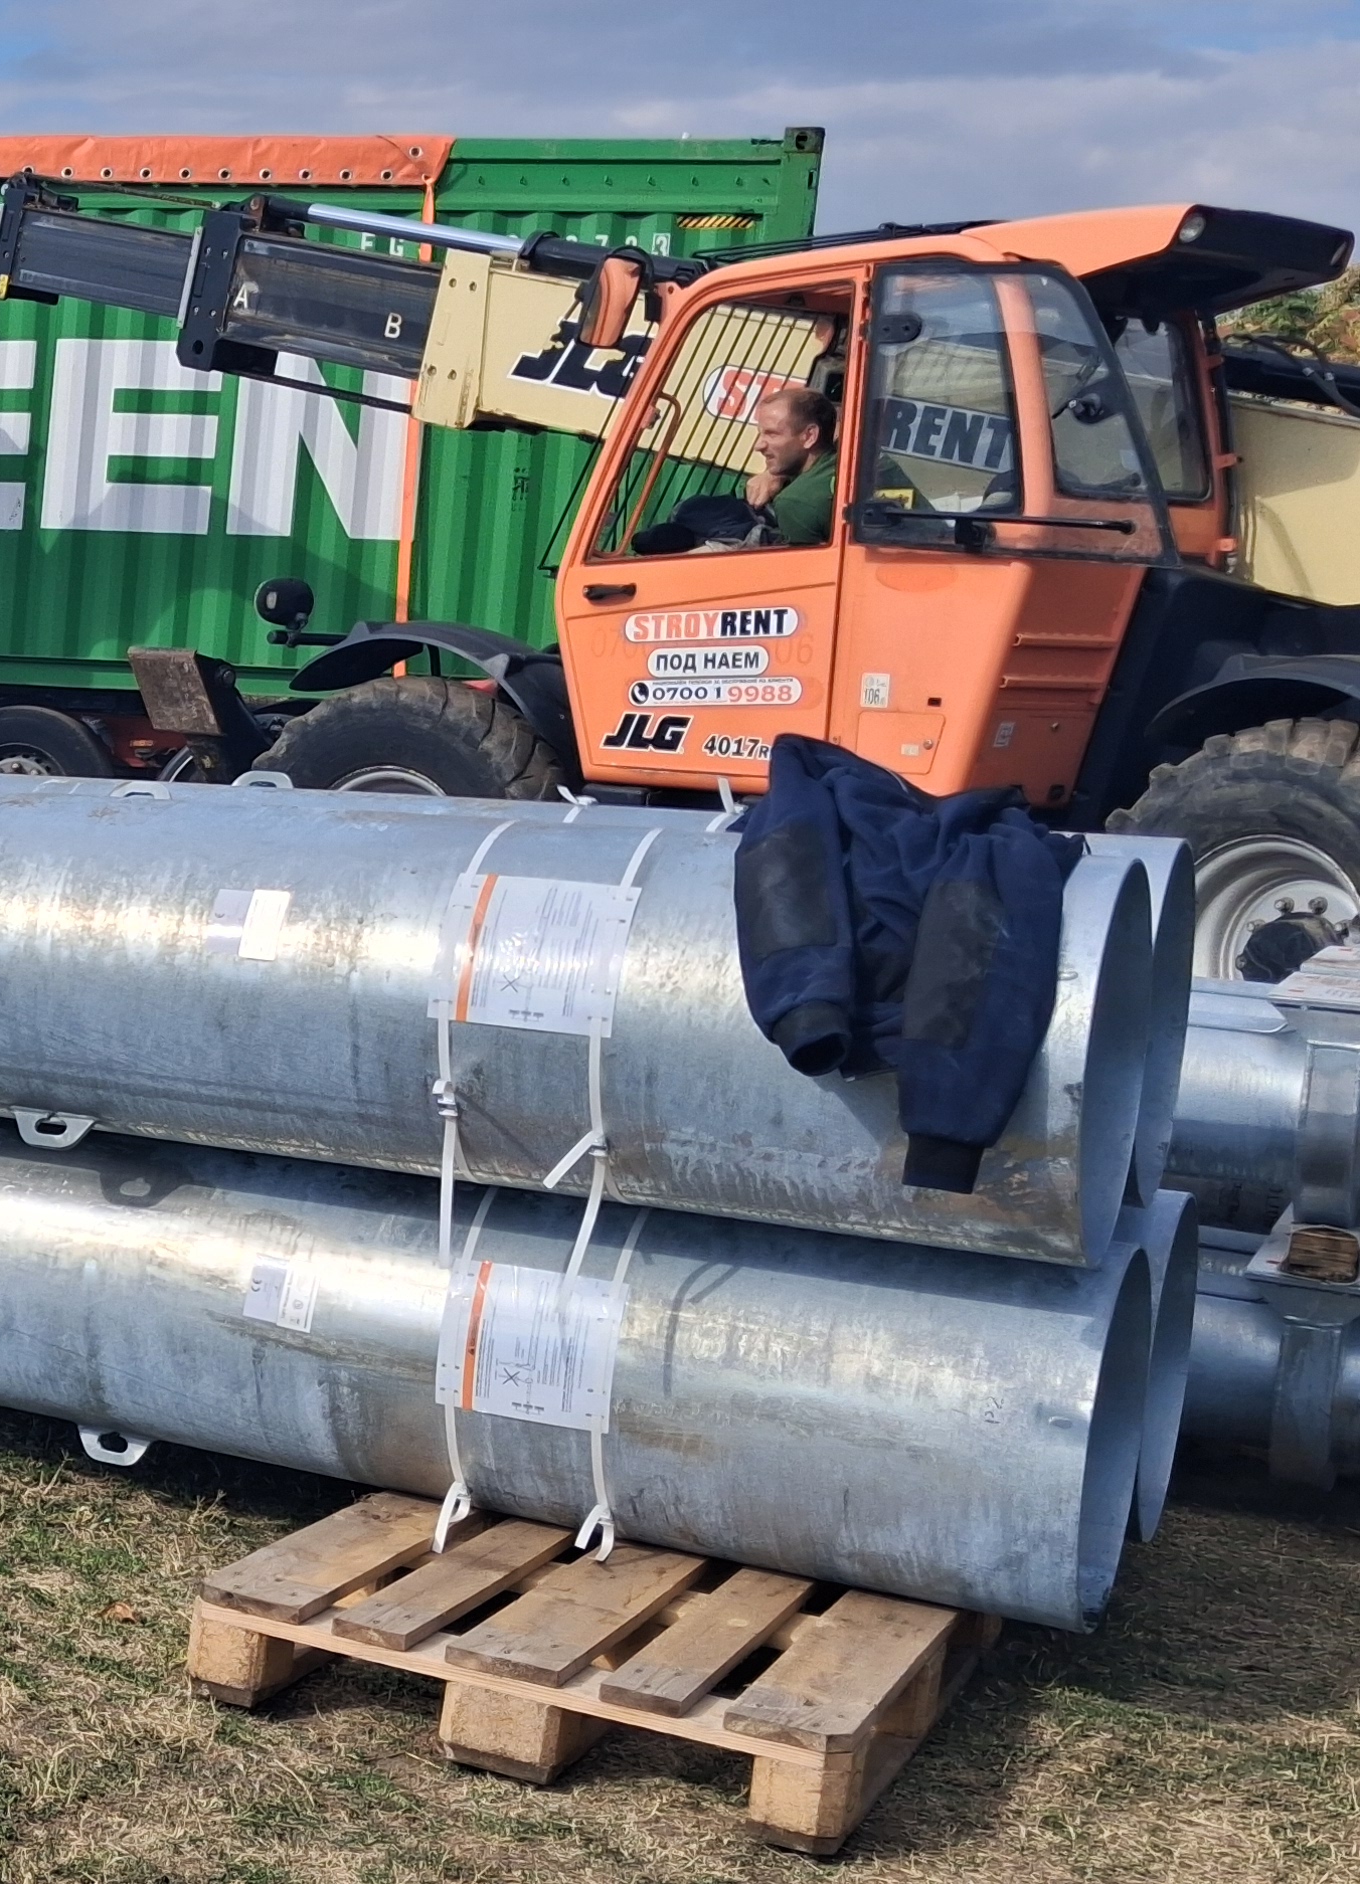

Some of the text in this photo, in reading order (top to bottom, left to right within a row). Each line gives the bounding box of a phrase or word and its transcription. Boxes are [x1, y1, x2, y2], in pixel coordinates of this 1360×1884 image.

[233, 290, 250, 309] A
[384, 313, 402, 339] B
[633, 609, 789, 640] STROYRENT
[655, 652, 760, 673] ПОД НАЕМ
[652, 686, 708, 701] 0700
[727, 685, 793, 703] 9988
[602, 713, 692, 751] JLG
